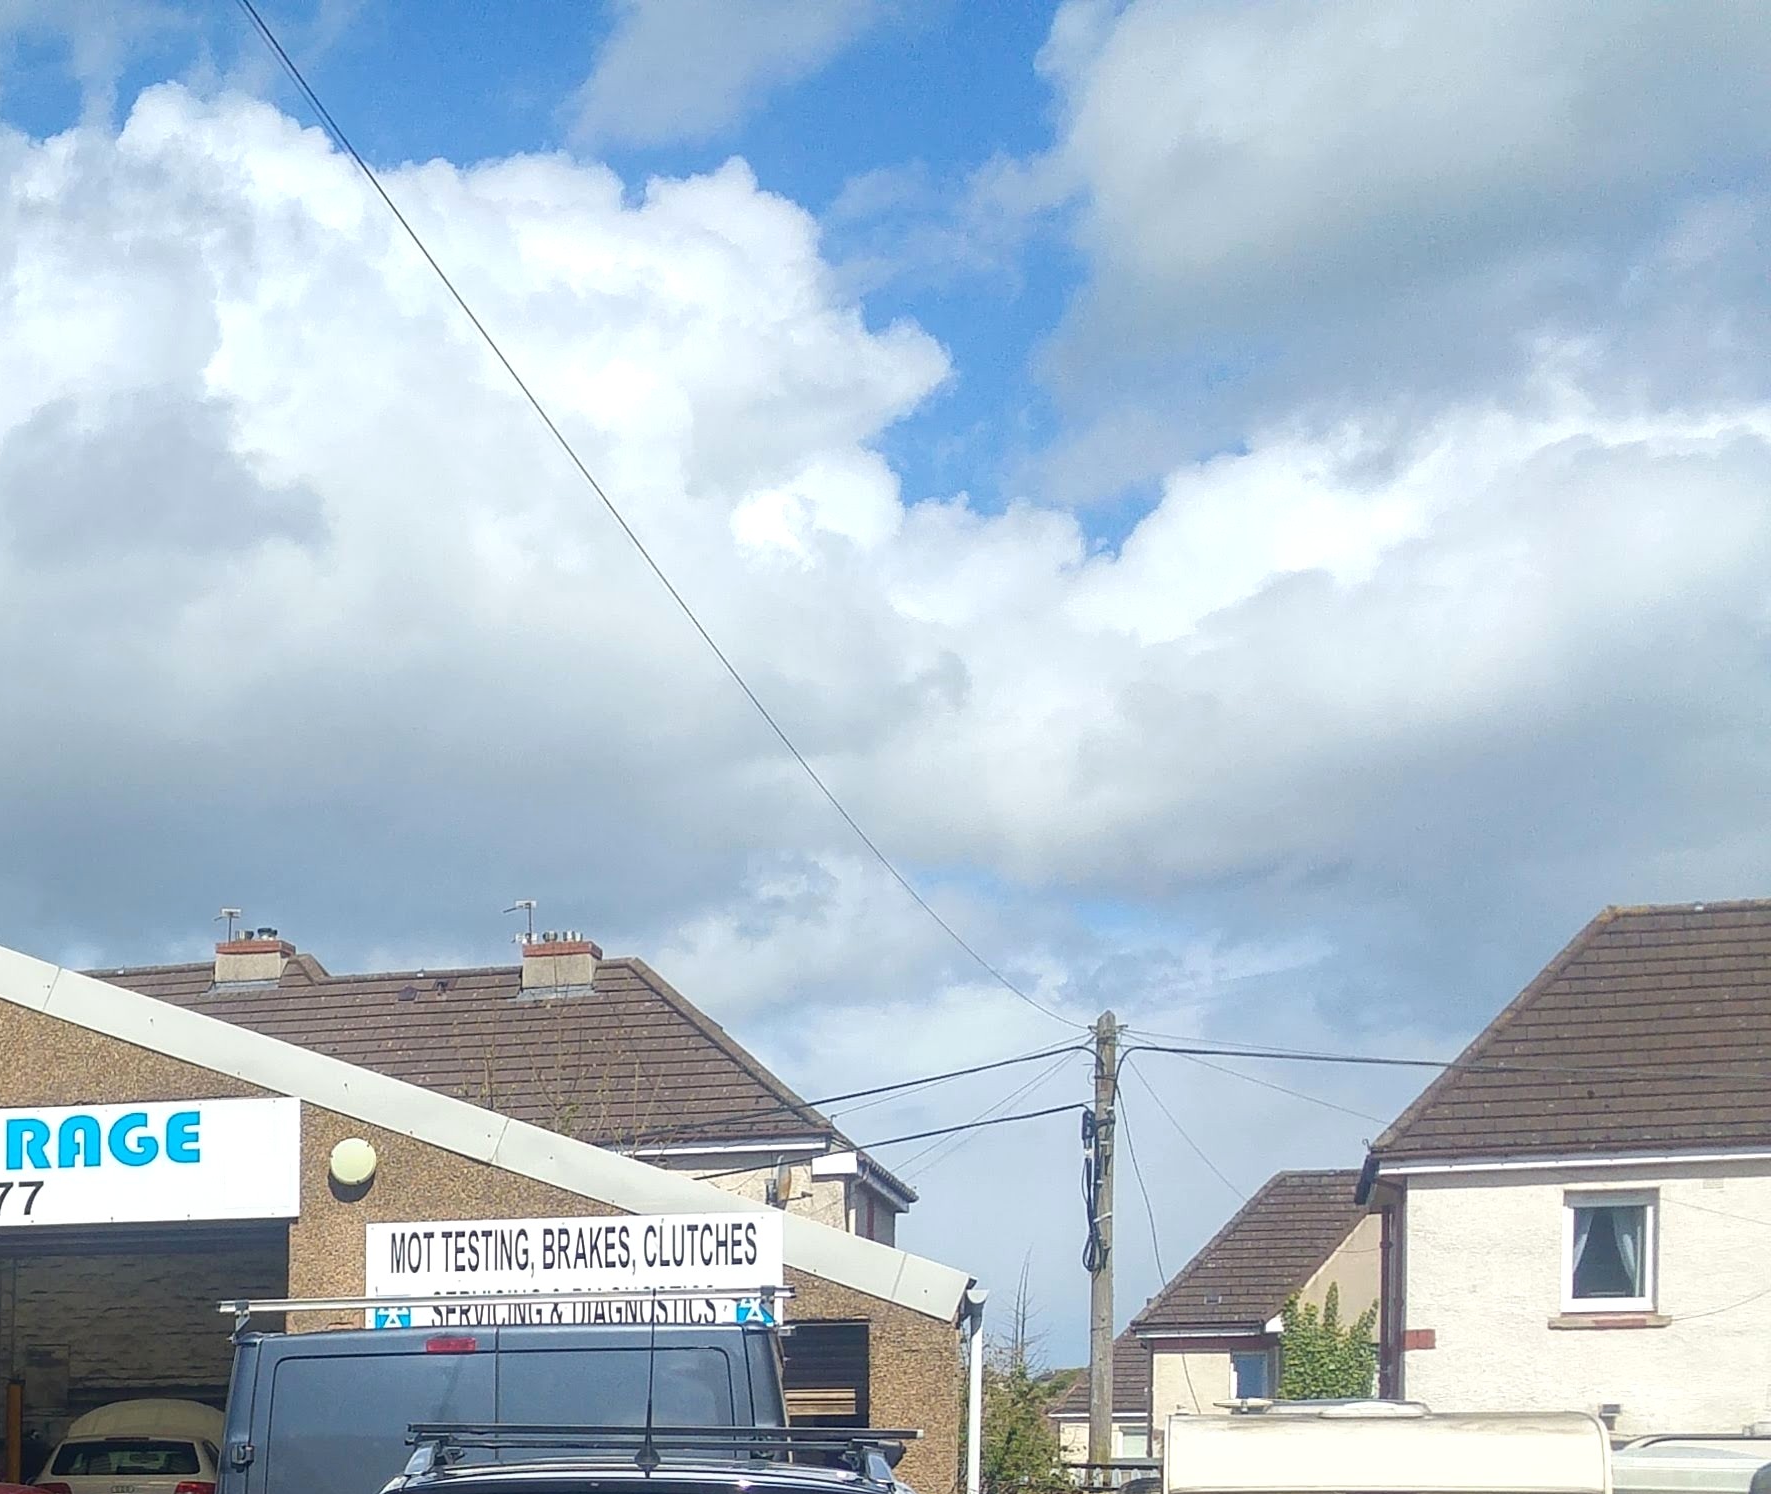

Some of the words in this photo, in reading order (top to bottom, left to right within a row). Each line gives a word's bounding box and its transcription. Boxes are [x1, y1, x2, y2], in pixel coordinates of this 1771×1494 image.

[390, 1231, 435, 1274] MOT
[441, 1228, 535, 1277] TESTING,
[543, 1226, 637, 1275] BRAKES,
[644, 1222, 758, 1267] CLUTCHES
